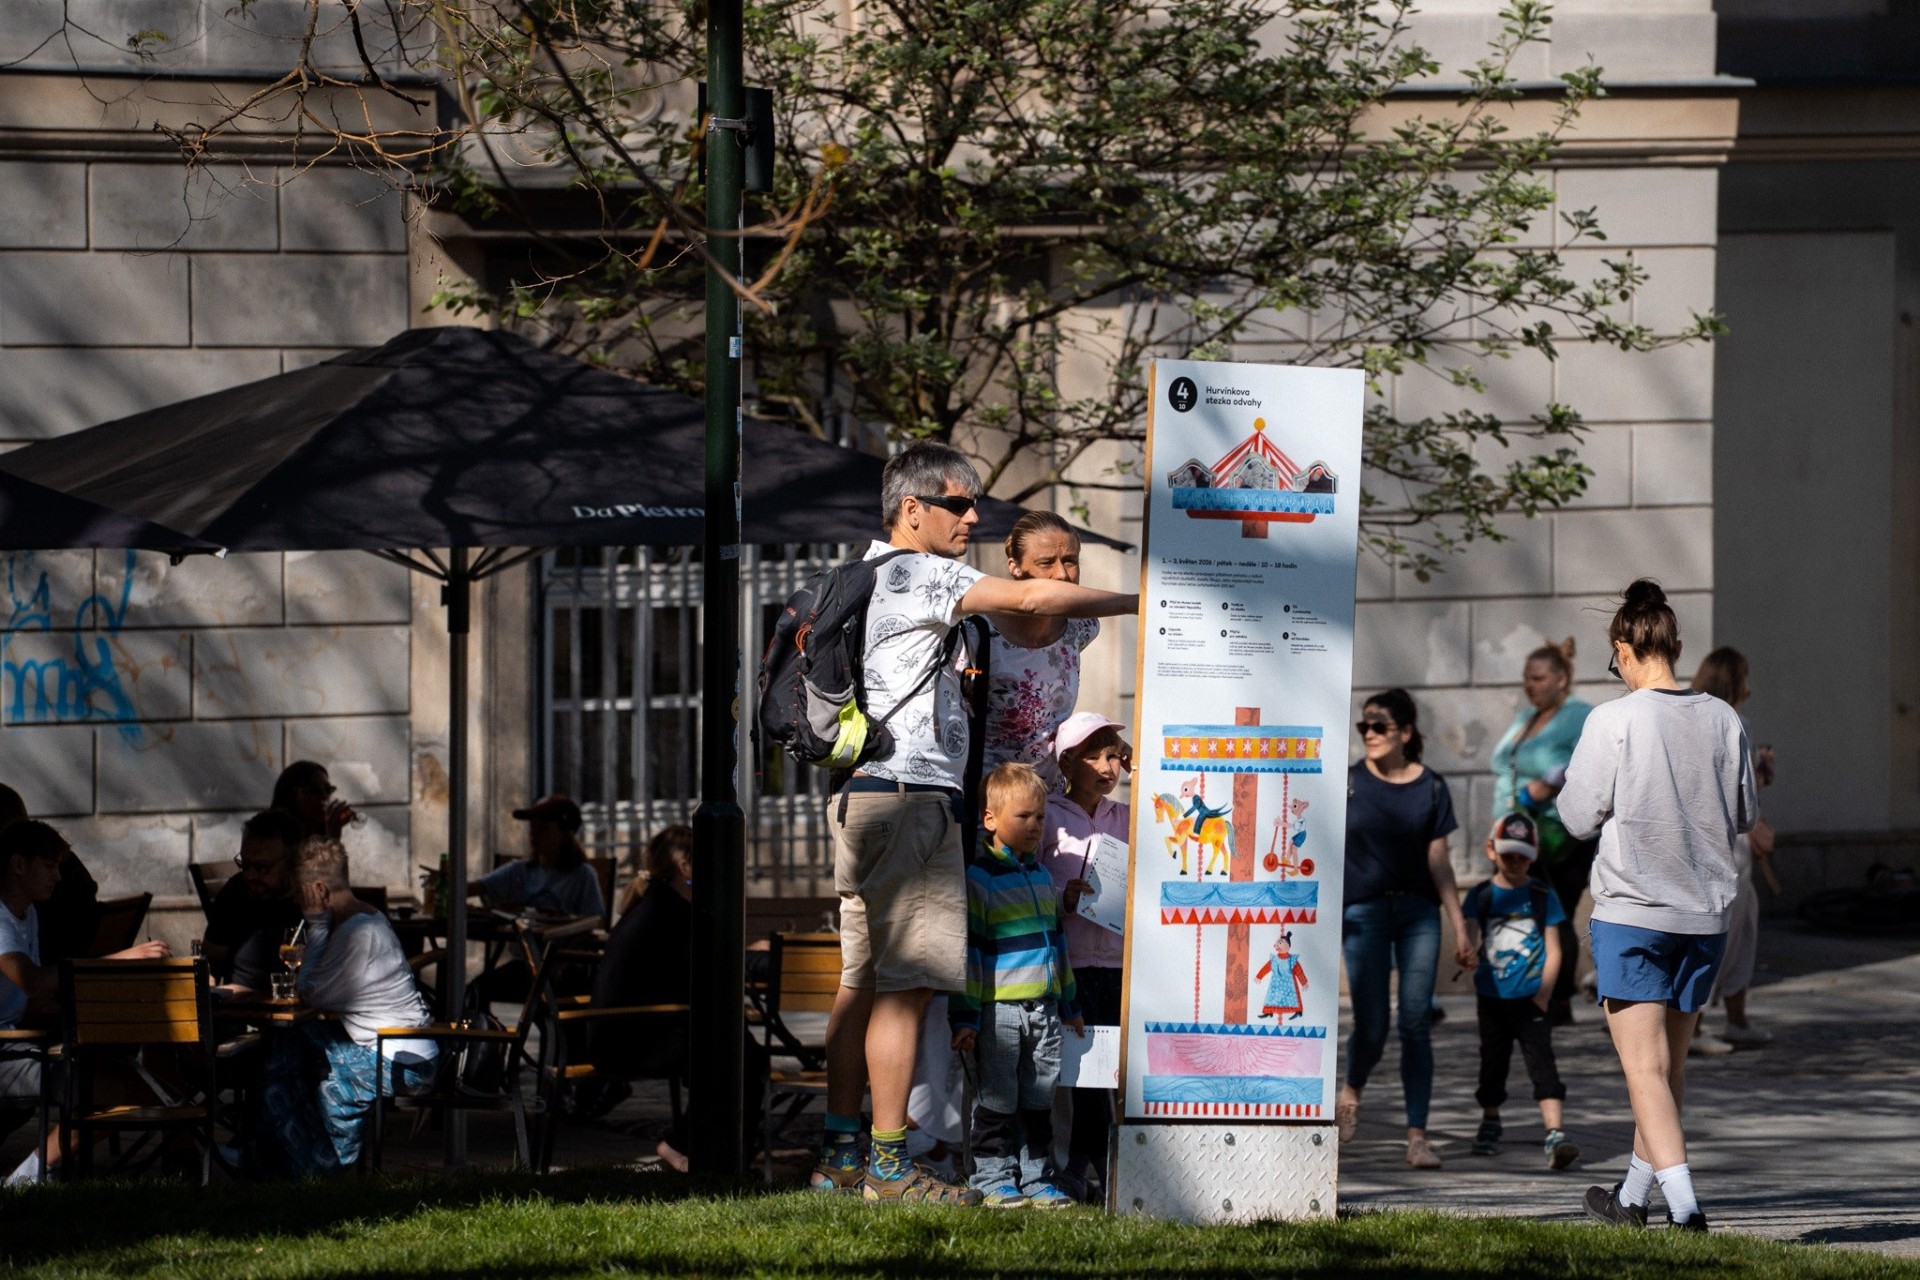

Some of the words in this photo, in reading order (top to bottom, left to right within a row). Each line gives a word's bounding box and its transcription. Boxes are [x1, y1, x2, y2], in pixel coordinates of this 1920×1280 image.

[1177, 382, 1189, 400] 4
[1205, 396, 1232, 405] stezka
[1233, 398, 1262, 408] odvahy
